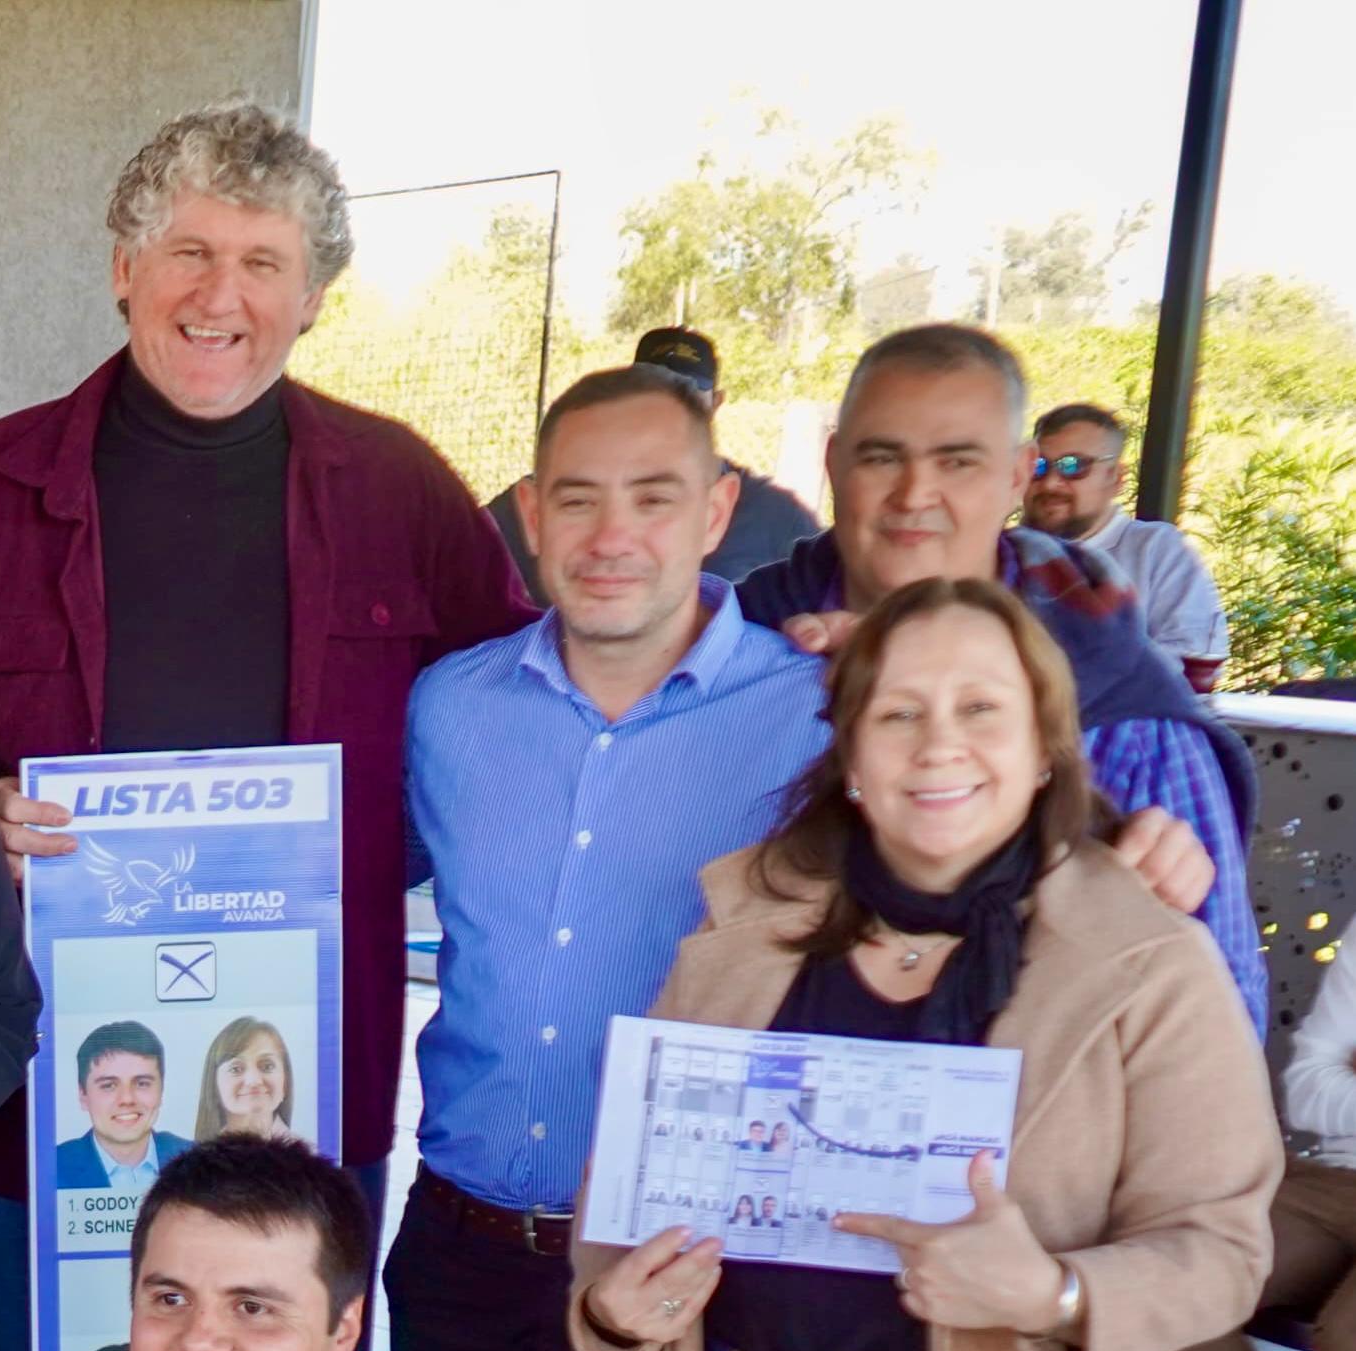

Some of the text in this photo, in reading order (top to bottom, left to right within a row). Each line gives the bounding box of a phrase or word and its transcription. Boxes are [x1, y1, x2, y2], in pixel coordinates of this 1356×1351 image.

[72, 778, 293, 817] LISTA 503
[174, 881, 194, 895] LA
[173, 890, 286, 912] LIBERTAD
[222, 909, 286, 924] AVANZA
[68, 1196, 138, 1212] 1. GODOY
[68, 1220, 80, 1235] 2.
